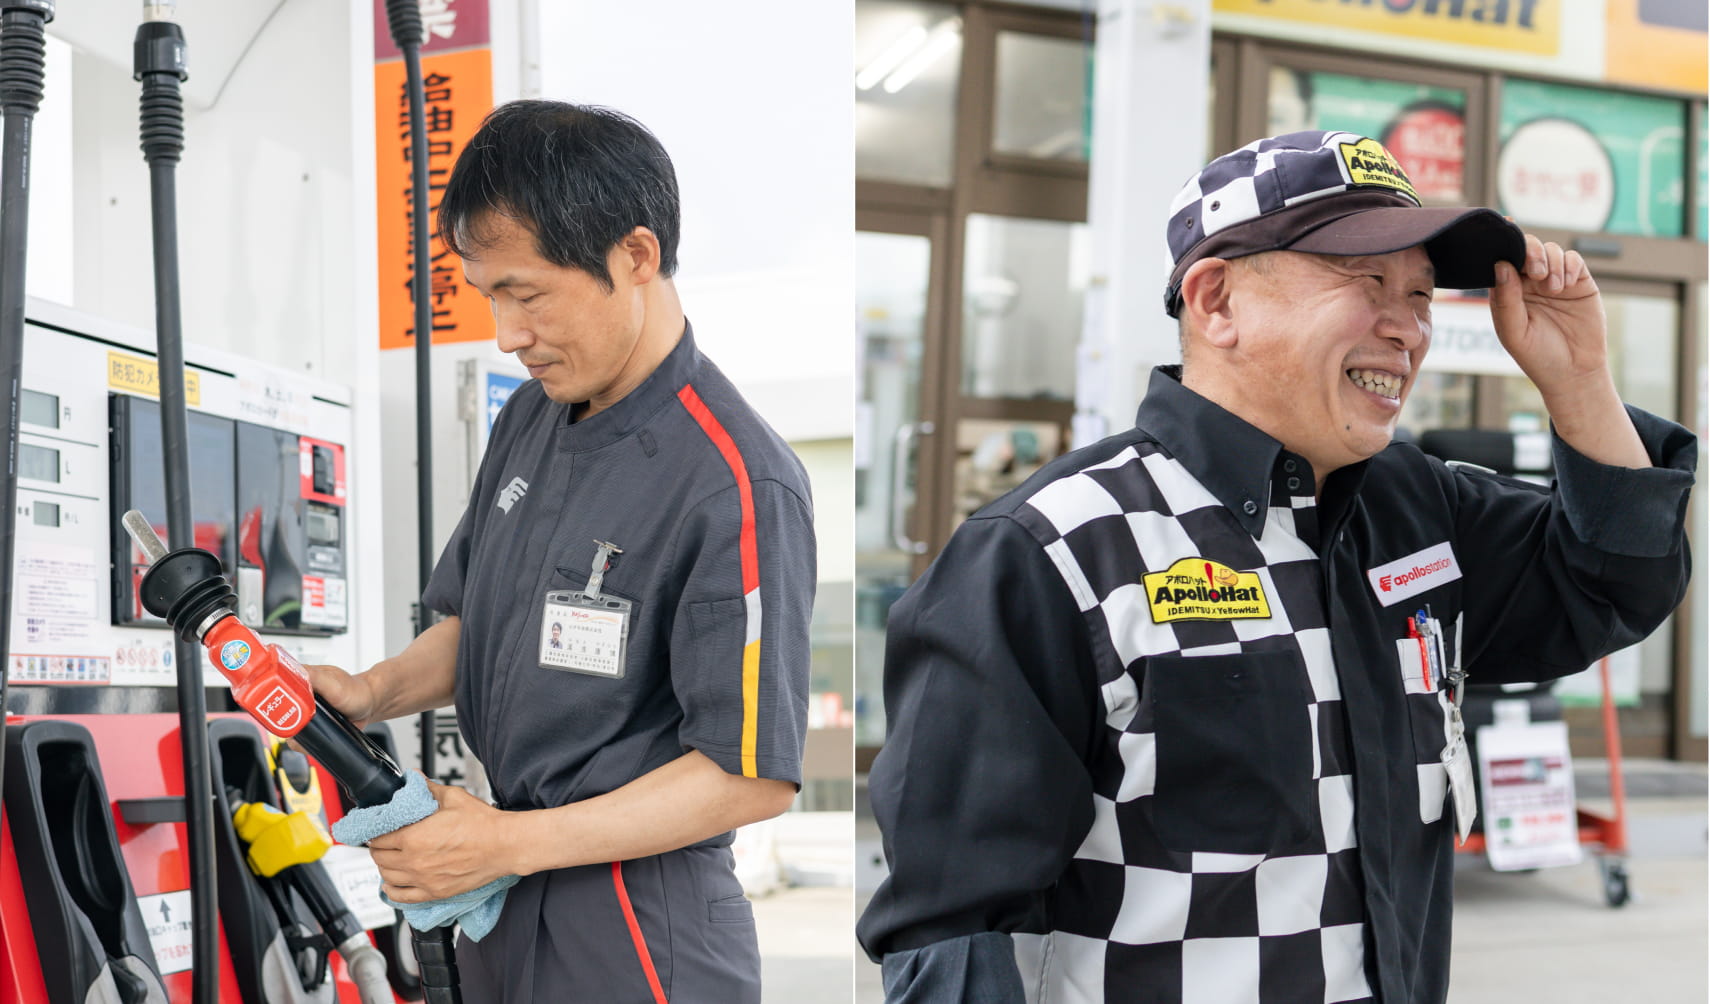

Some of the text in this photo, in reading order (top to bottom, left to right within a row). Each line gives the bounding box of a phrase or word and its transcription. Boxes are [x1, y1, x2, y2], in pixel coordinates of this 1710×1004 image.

[112, 360, 197, 397] 防犯カメ中
[1165, 575, 1207, 586] アポロハット
[1393, 557, 1453, 587] apollostation
[1153, 586, 1260, 605] ApolloHat
